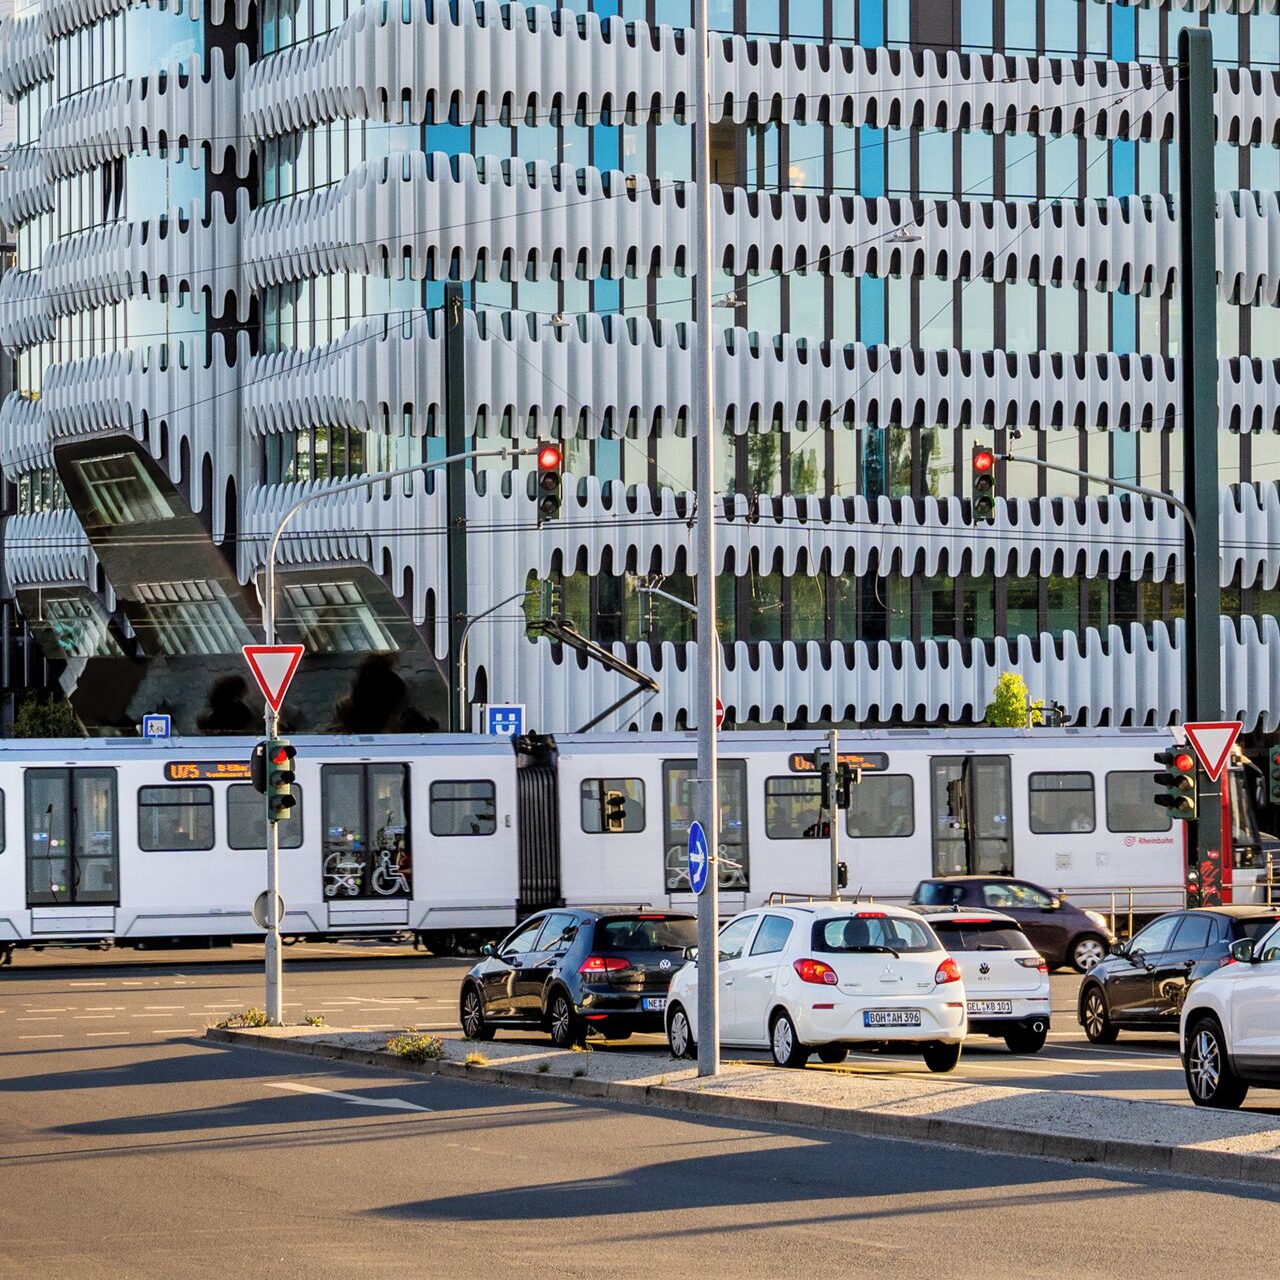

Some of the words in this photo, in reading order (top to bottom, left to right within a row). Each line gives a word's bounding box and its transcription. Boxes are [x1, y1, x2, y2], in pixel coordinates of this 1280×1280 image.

[170, 764, 200, 779] U75
[966, 1002, 981, 1011] GEL
[996, 1002, 1010, 1011] 101
[870, 1012, 886, 1023] BOH
[904, 1012, 920, 1023] 396
